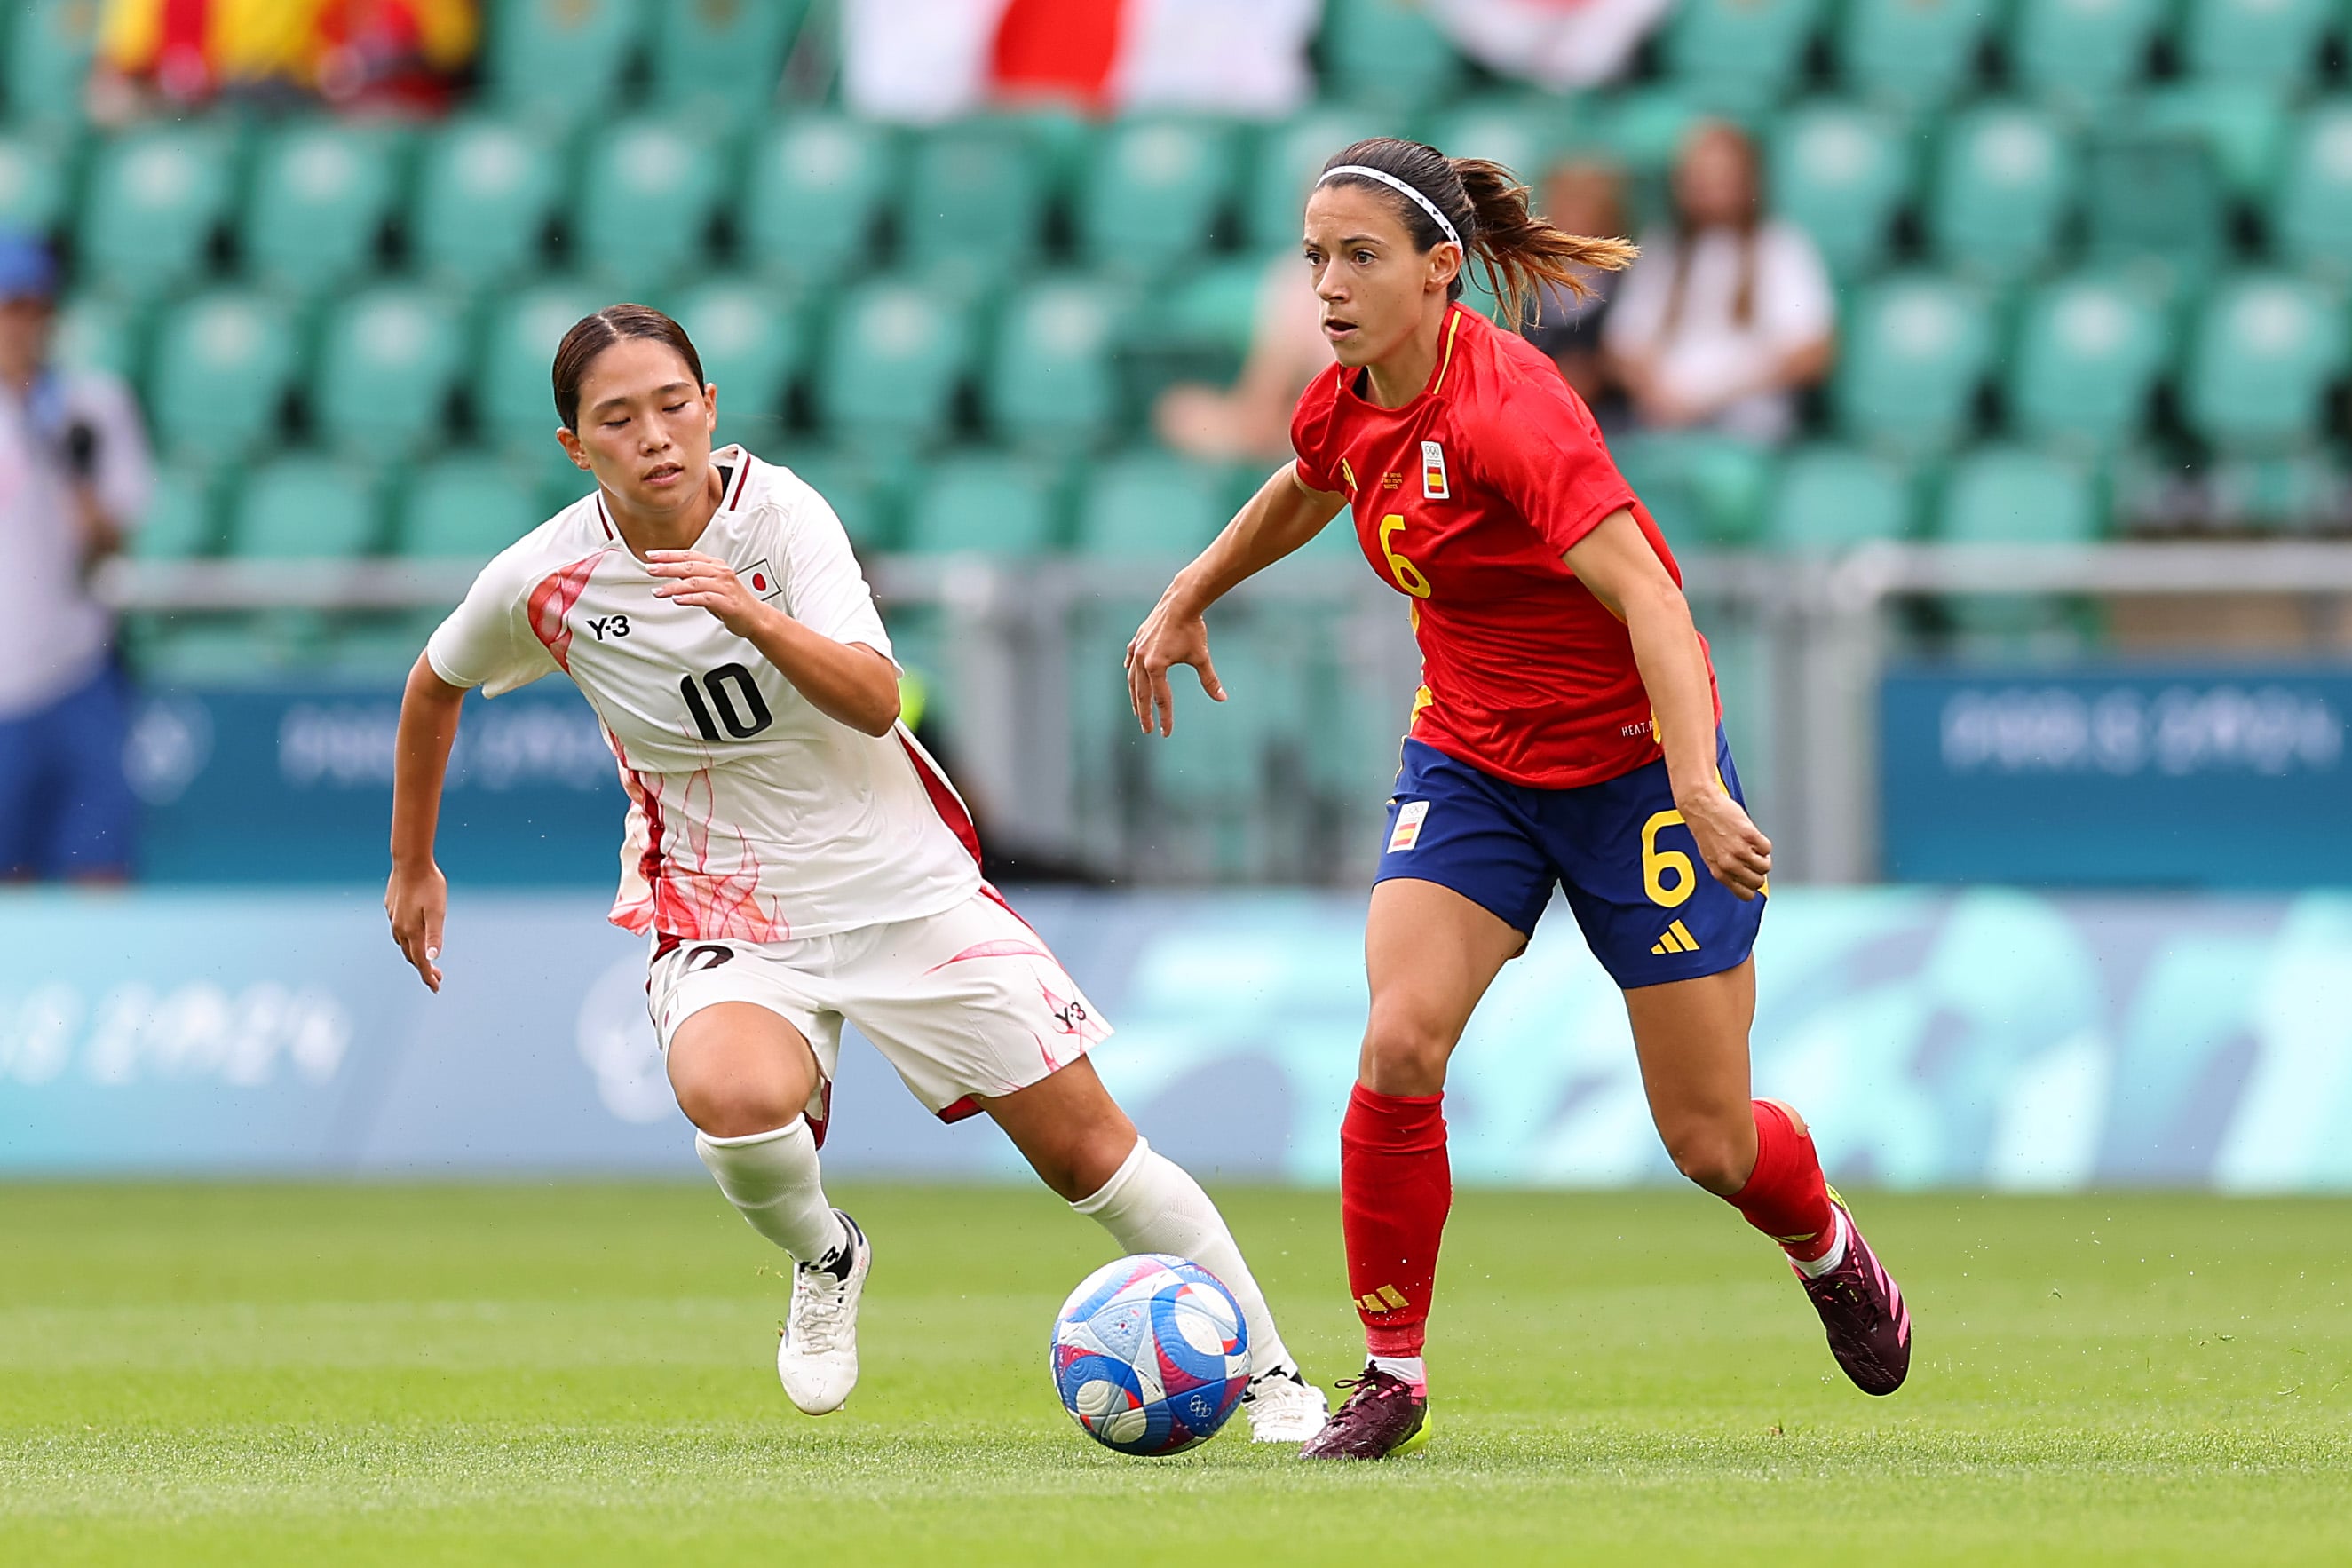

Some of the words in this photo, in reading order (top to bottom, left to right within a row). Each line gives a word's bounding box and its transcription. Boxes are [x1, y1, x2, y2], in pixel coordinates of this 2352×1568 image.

[1379, 514, 1431, 598] 6
[586, 615, 630, 641] Y-3
[680, 662, 772, 740] 10
[1641, 809, 1696, 907] 6
[1055, 1002, 1086, 1029] Y-3
